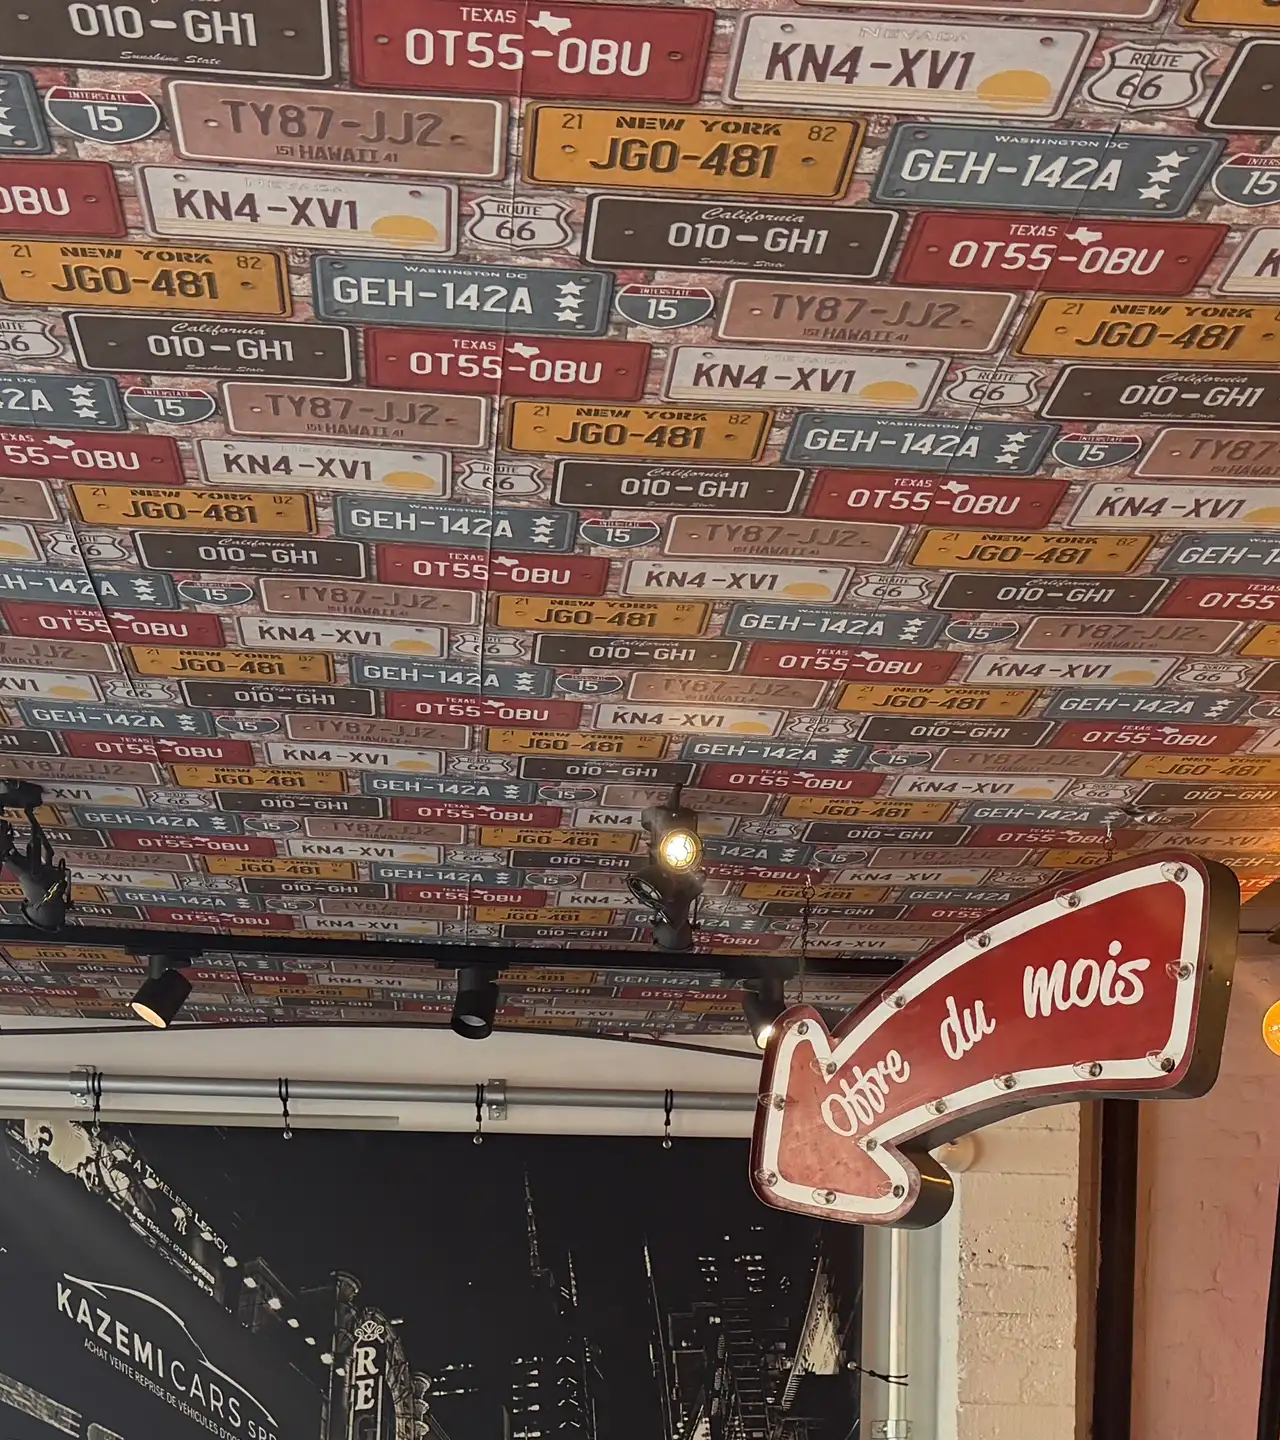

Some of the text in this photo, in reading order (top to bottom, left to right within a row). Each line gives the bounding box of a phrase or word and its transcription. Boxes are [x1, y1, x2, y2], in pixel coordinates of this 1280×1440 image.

[460, 6, 516, 24] TEXAS
[1115, 73, 1163, 100] 66
[82, 104, 123, 132] 15
[701, 119, 781, 136] YORK
[900, 148, 1122, 191] GEH-142A
[700, 206, 805, 223] California
[495, 219, 535, 241] 66
[1009, 223, 1058, 237] TEXAS
[332, 275, 532, 314] GEH-142A
[647, 298, 678, 320] 15
[821, 939, 1150, 1137] Offre du mois
[56, 1281, 164, 1379] KAZEMI
[170, 1360, 242, 1428] CARS
[84, 1338, 108, 1361] ACHAT
[109, 1352, 134, 1380] VENTE
[135, 1369, 166, 1401] REPRISE
[166, 1391, 178, 1408] DE
[177, 1399, 219, 1436] VÉHICULES
